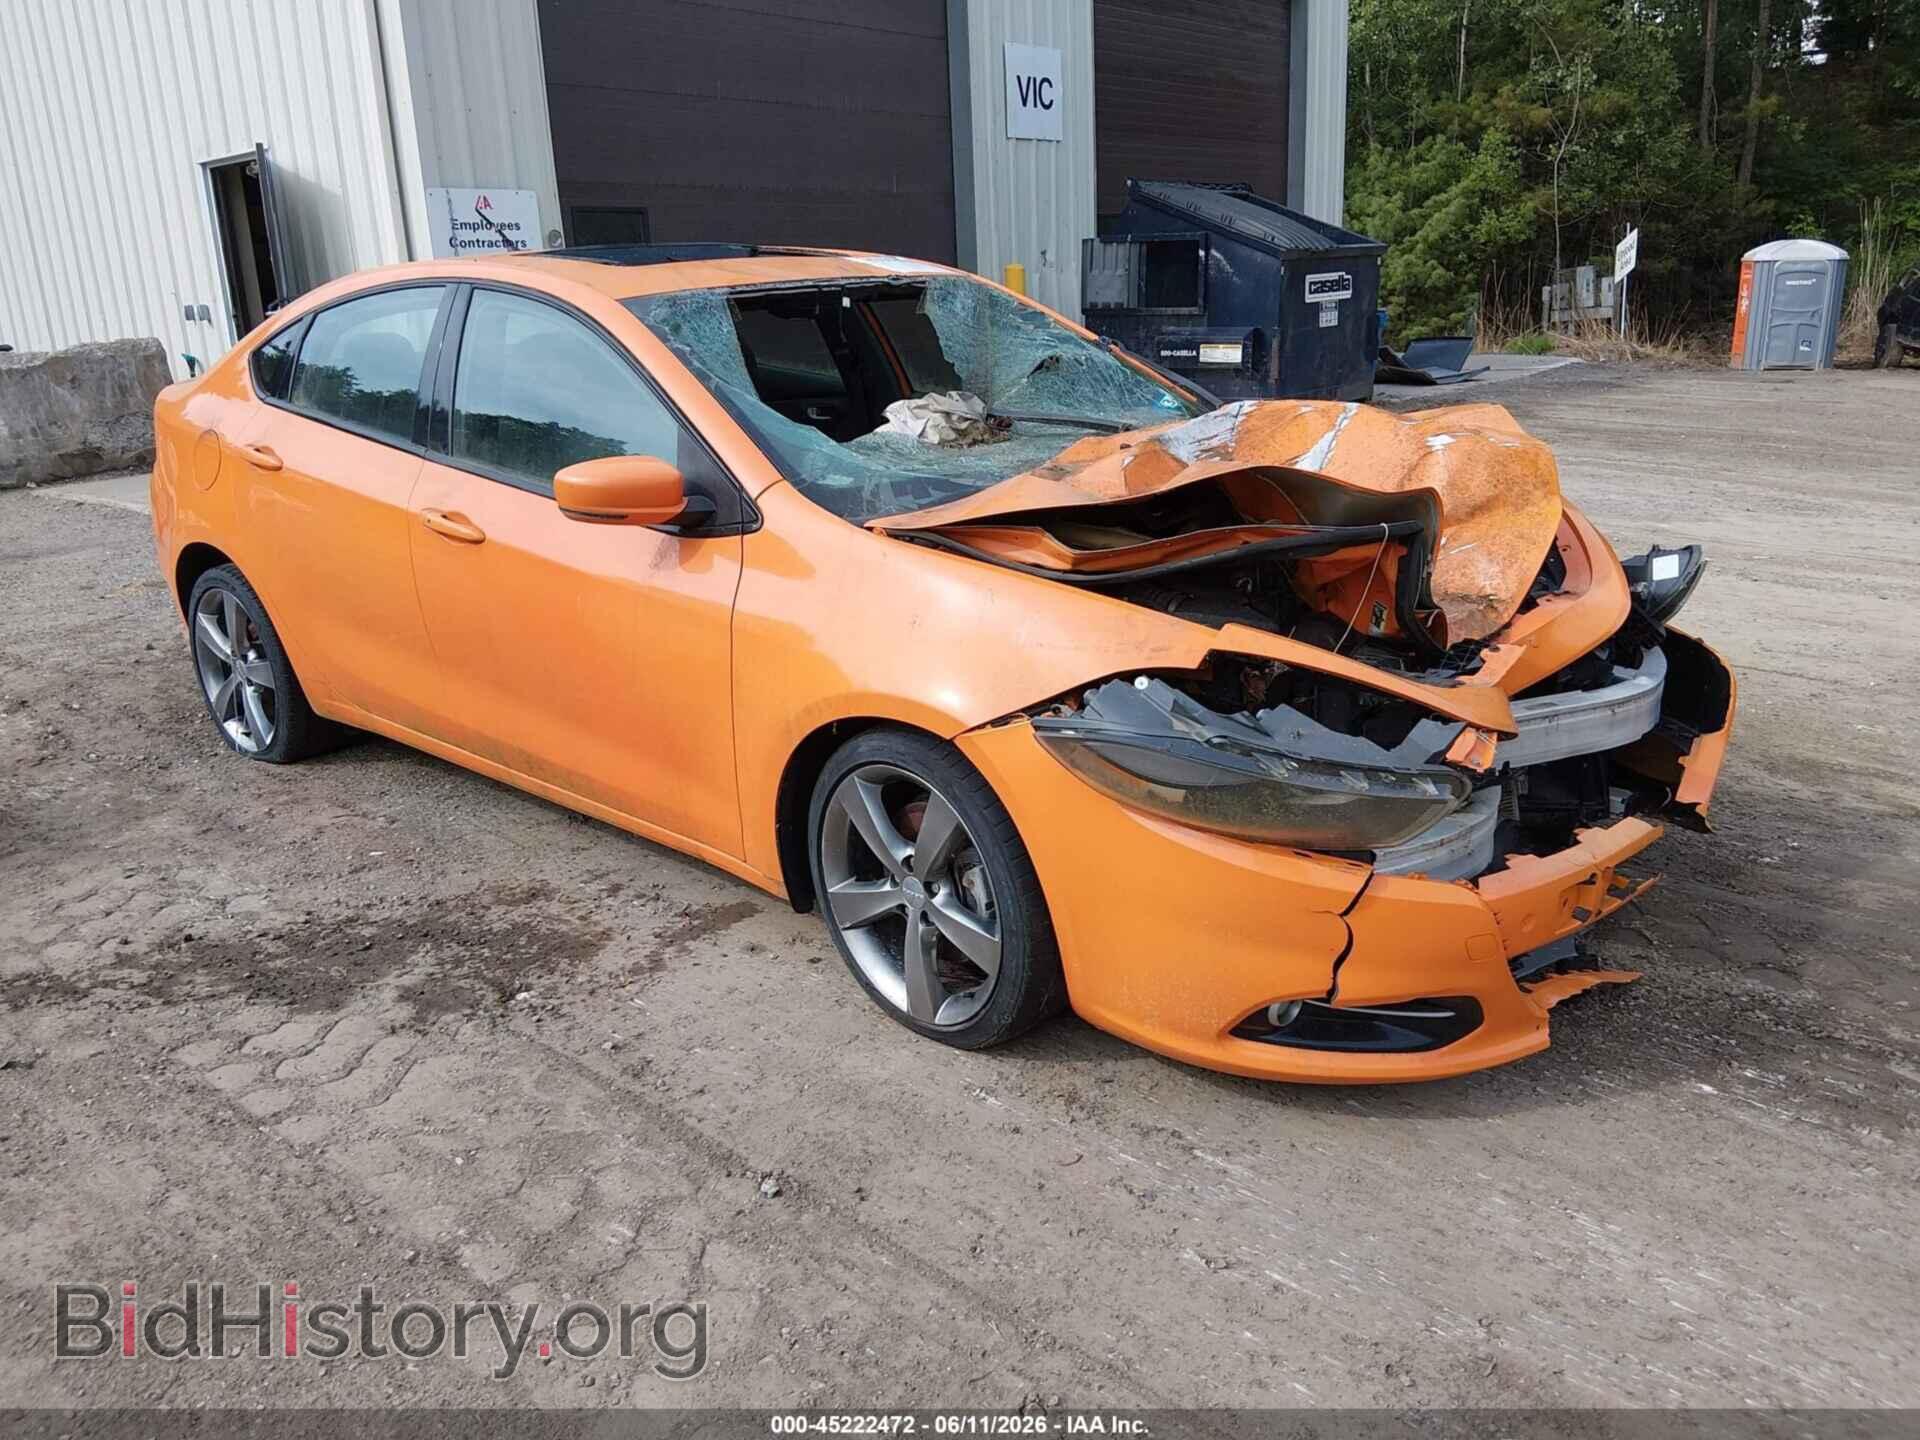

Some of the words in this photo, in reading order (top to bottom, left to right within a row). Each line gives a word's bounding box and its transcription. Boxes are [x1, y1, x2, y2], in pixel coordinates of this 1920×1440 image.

[1016, 74, 1054, 110] VIC
[451, 218, 521, 233] Employees
[1309, 274, 1350, 295] casella
